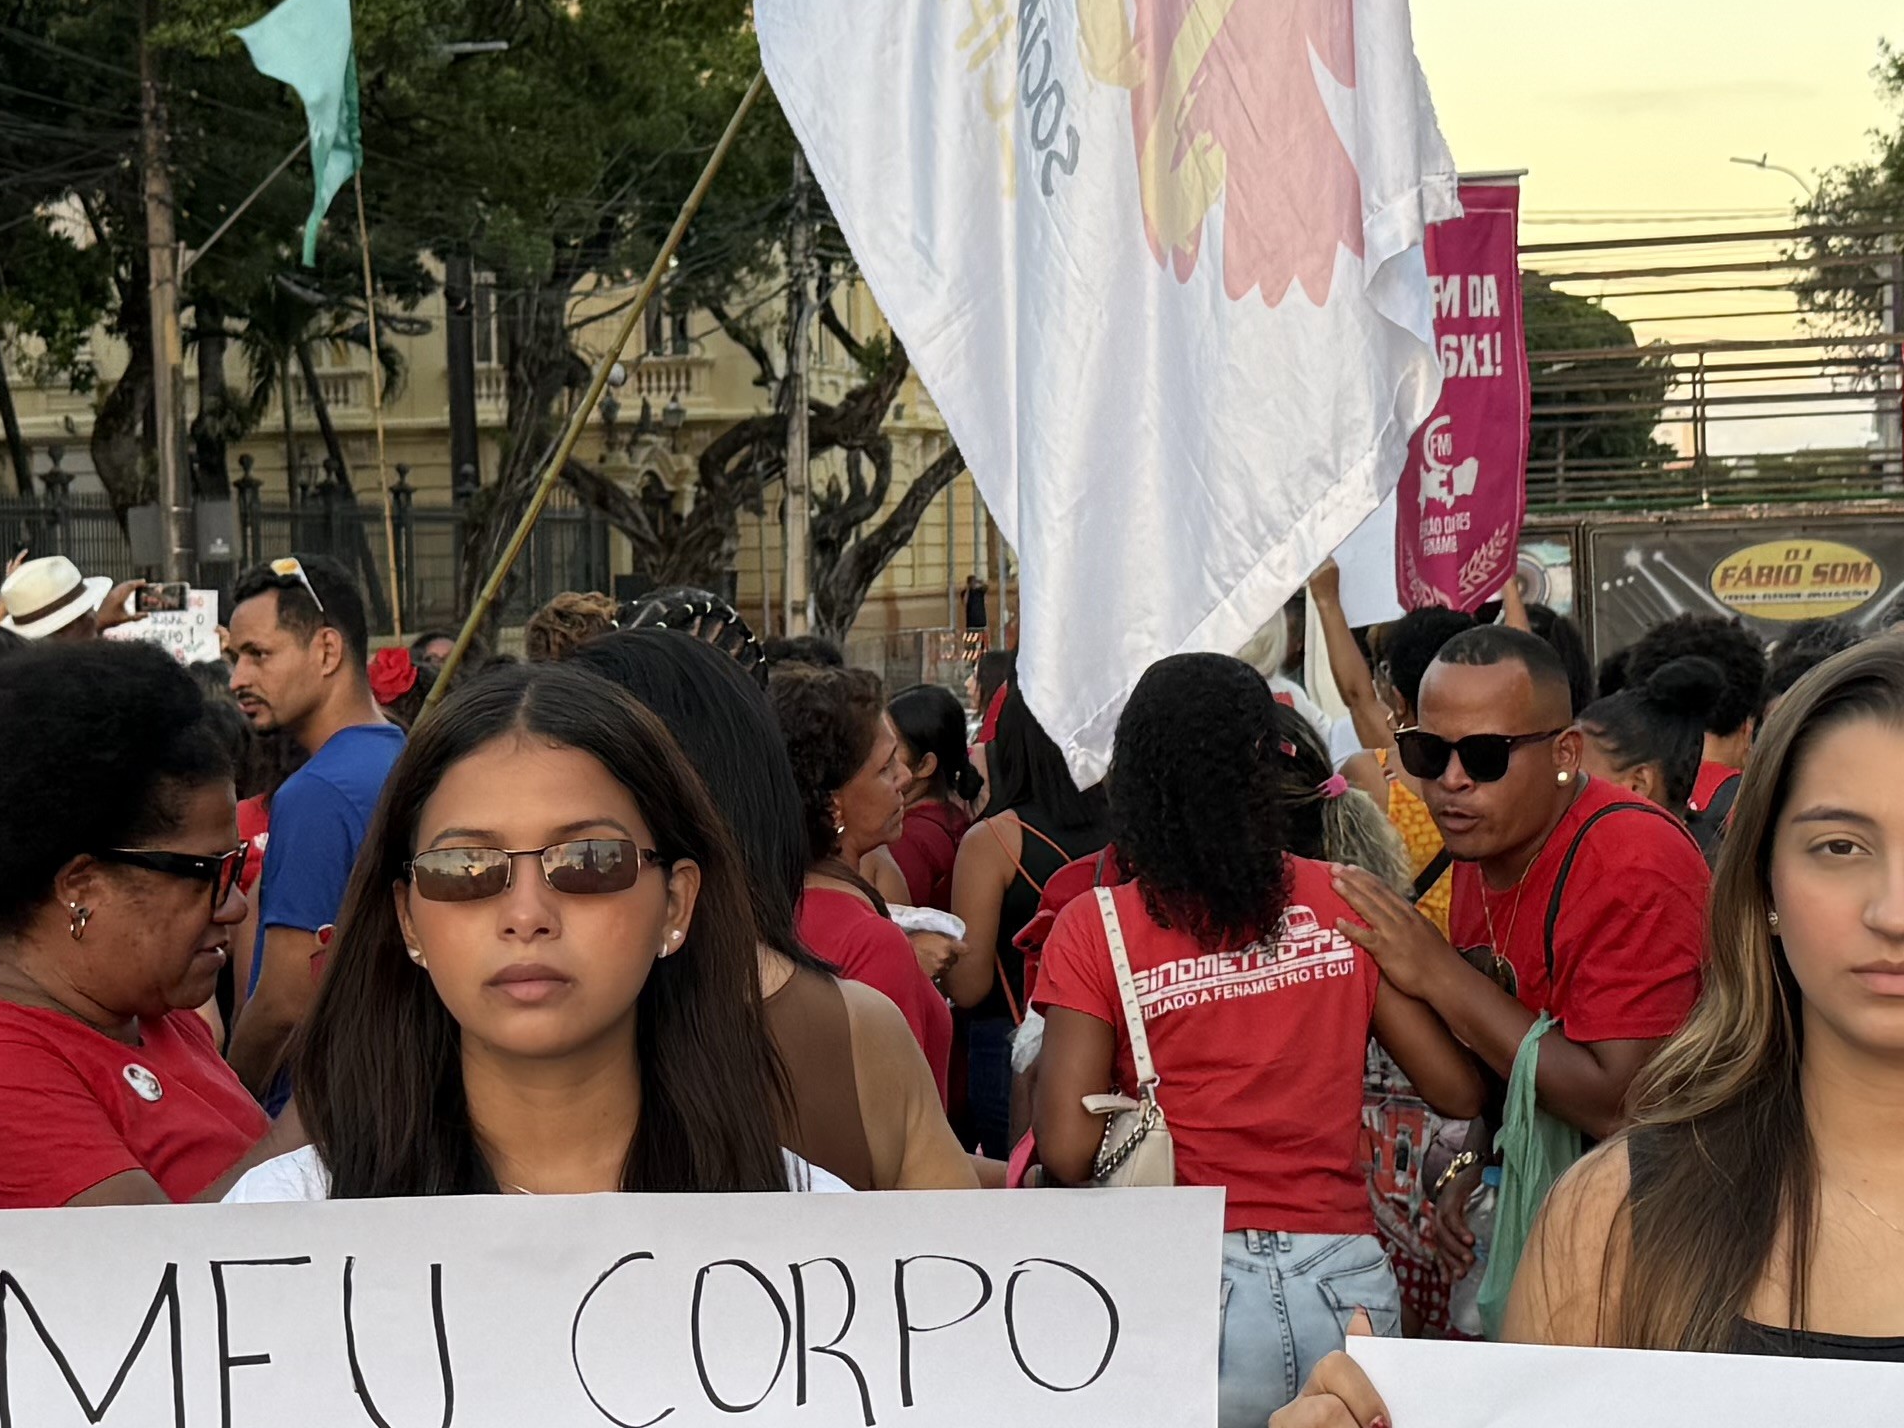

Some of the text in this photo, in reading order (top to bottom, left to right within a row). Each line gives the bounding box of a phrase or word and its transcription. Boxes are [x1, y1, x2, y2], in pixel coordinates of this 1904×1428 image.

[1467, 273, 1500, 318] DA
[1439, 330, 1502, 378] 6X1!
[1718, 558, 1875, 588] FÁBIO SOM
[1783, 548, 1813, 562] DJ
[1139, 992, 1198, 1022] ILIADO
[1199, 989, 1213, 1005] A
[1214, 967, 1310, 1002] FENAMETRO
[1314, 964, 1325, 980] E
[1326, 960, 1355, 977] CUT
